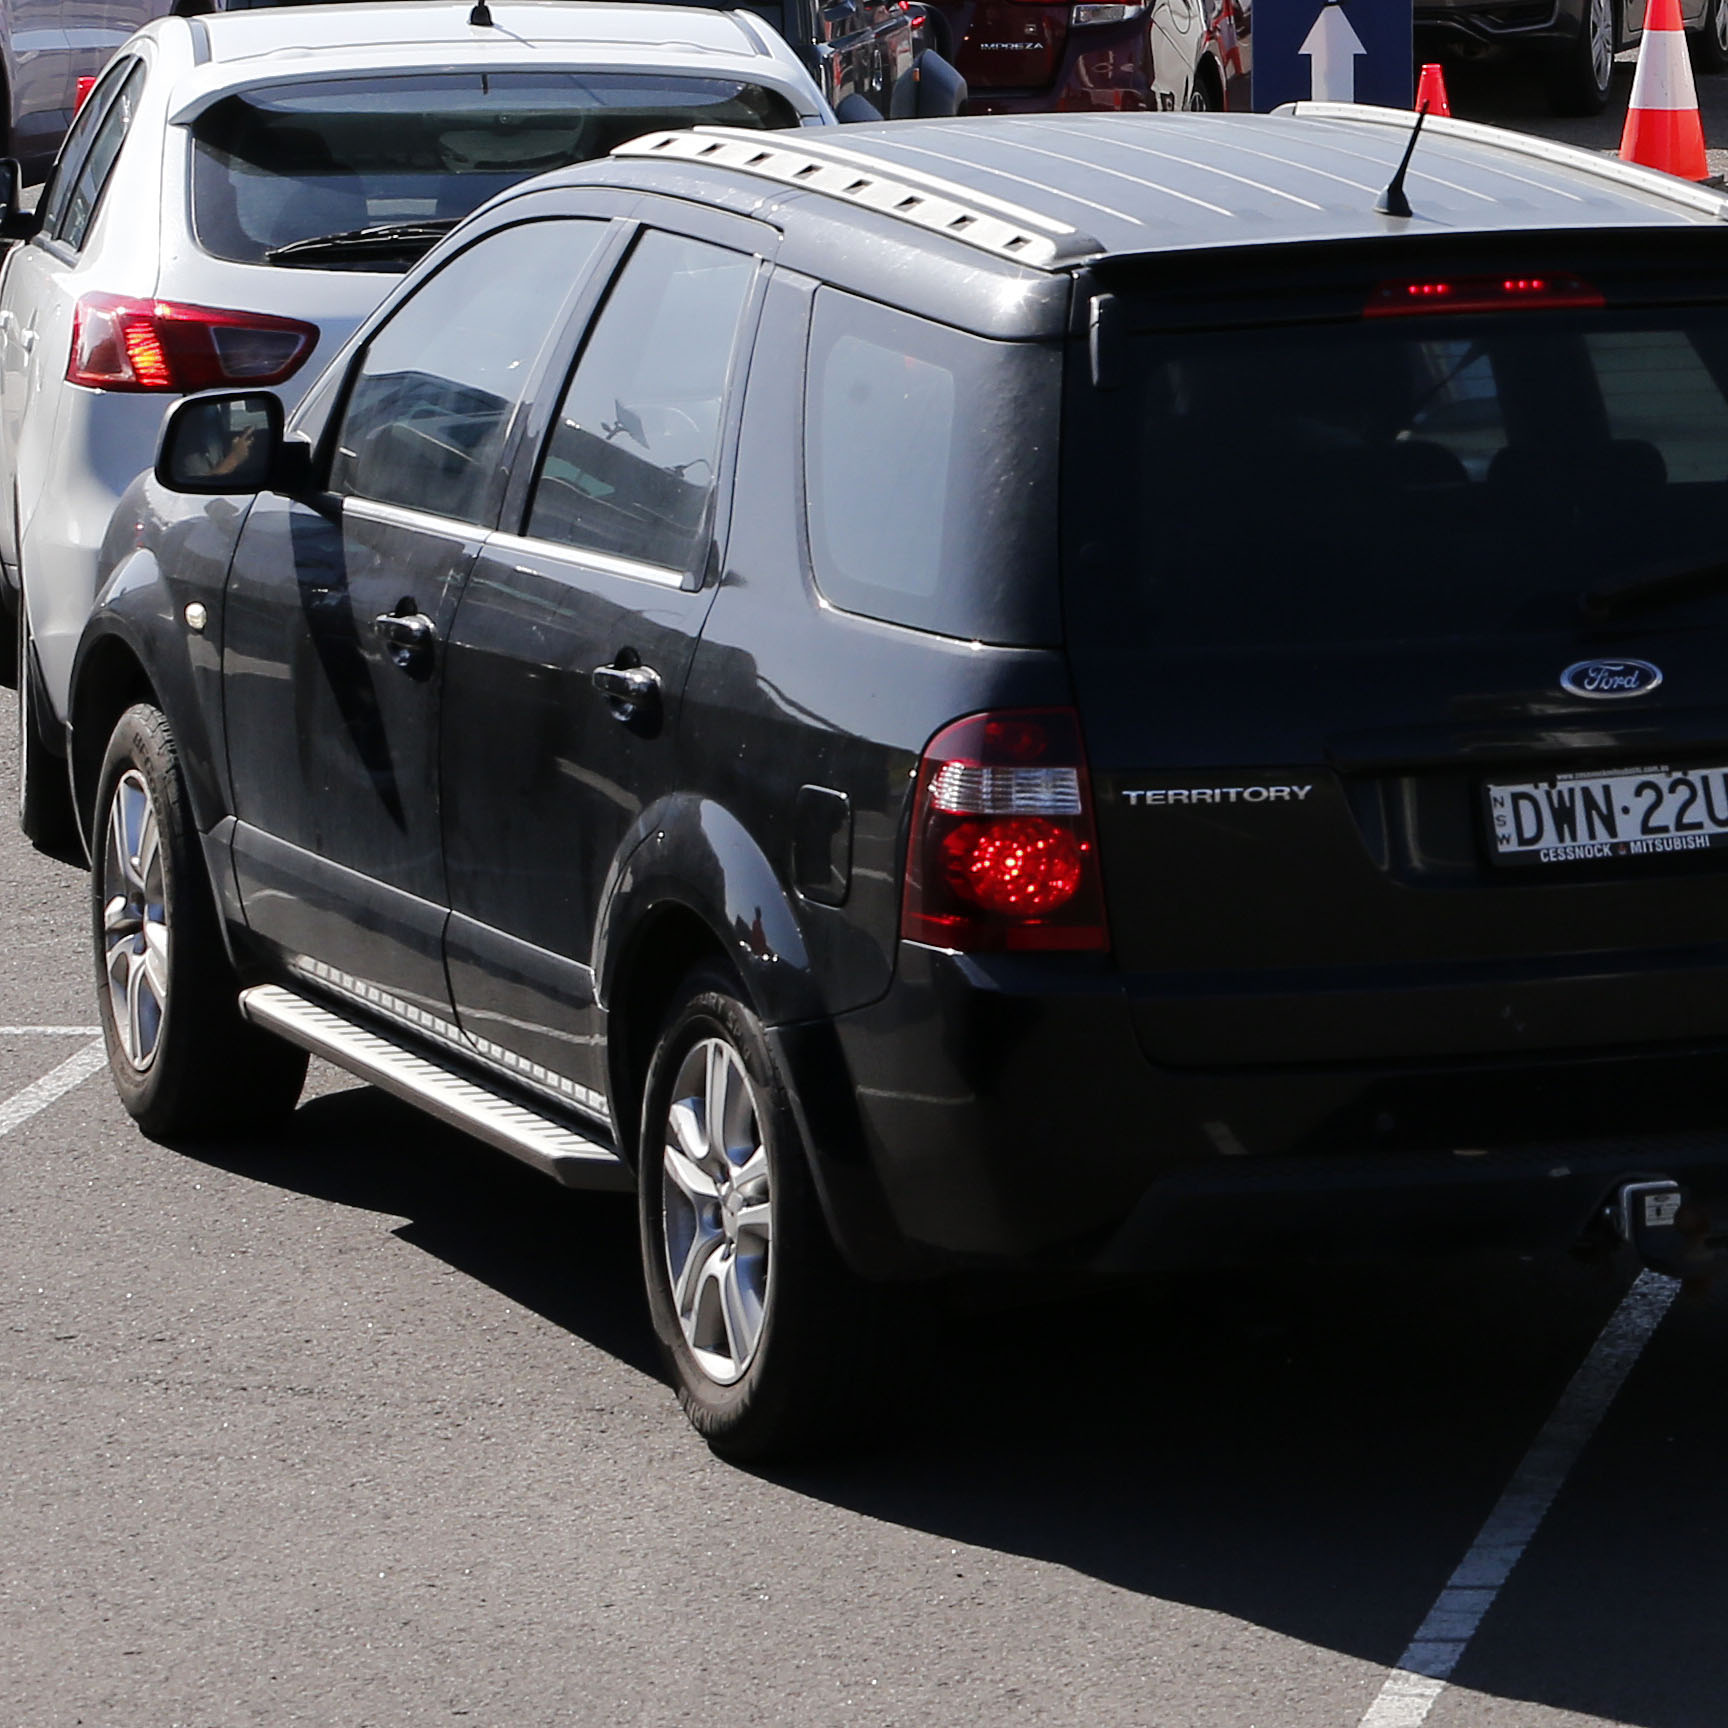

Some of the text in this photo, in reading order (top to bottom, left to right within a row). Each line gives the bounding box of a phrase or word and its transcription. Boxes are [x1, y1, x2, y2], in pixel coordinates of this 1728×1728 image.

[1584, 665, 1639, 690] Ford
[1122, 785, 1312, 806] TERRITORY
[1540, 835, 1711, 863] CESSNOCK MITSUBISHI
